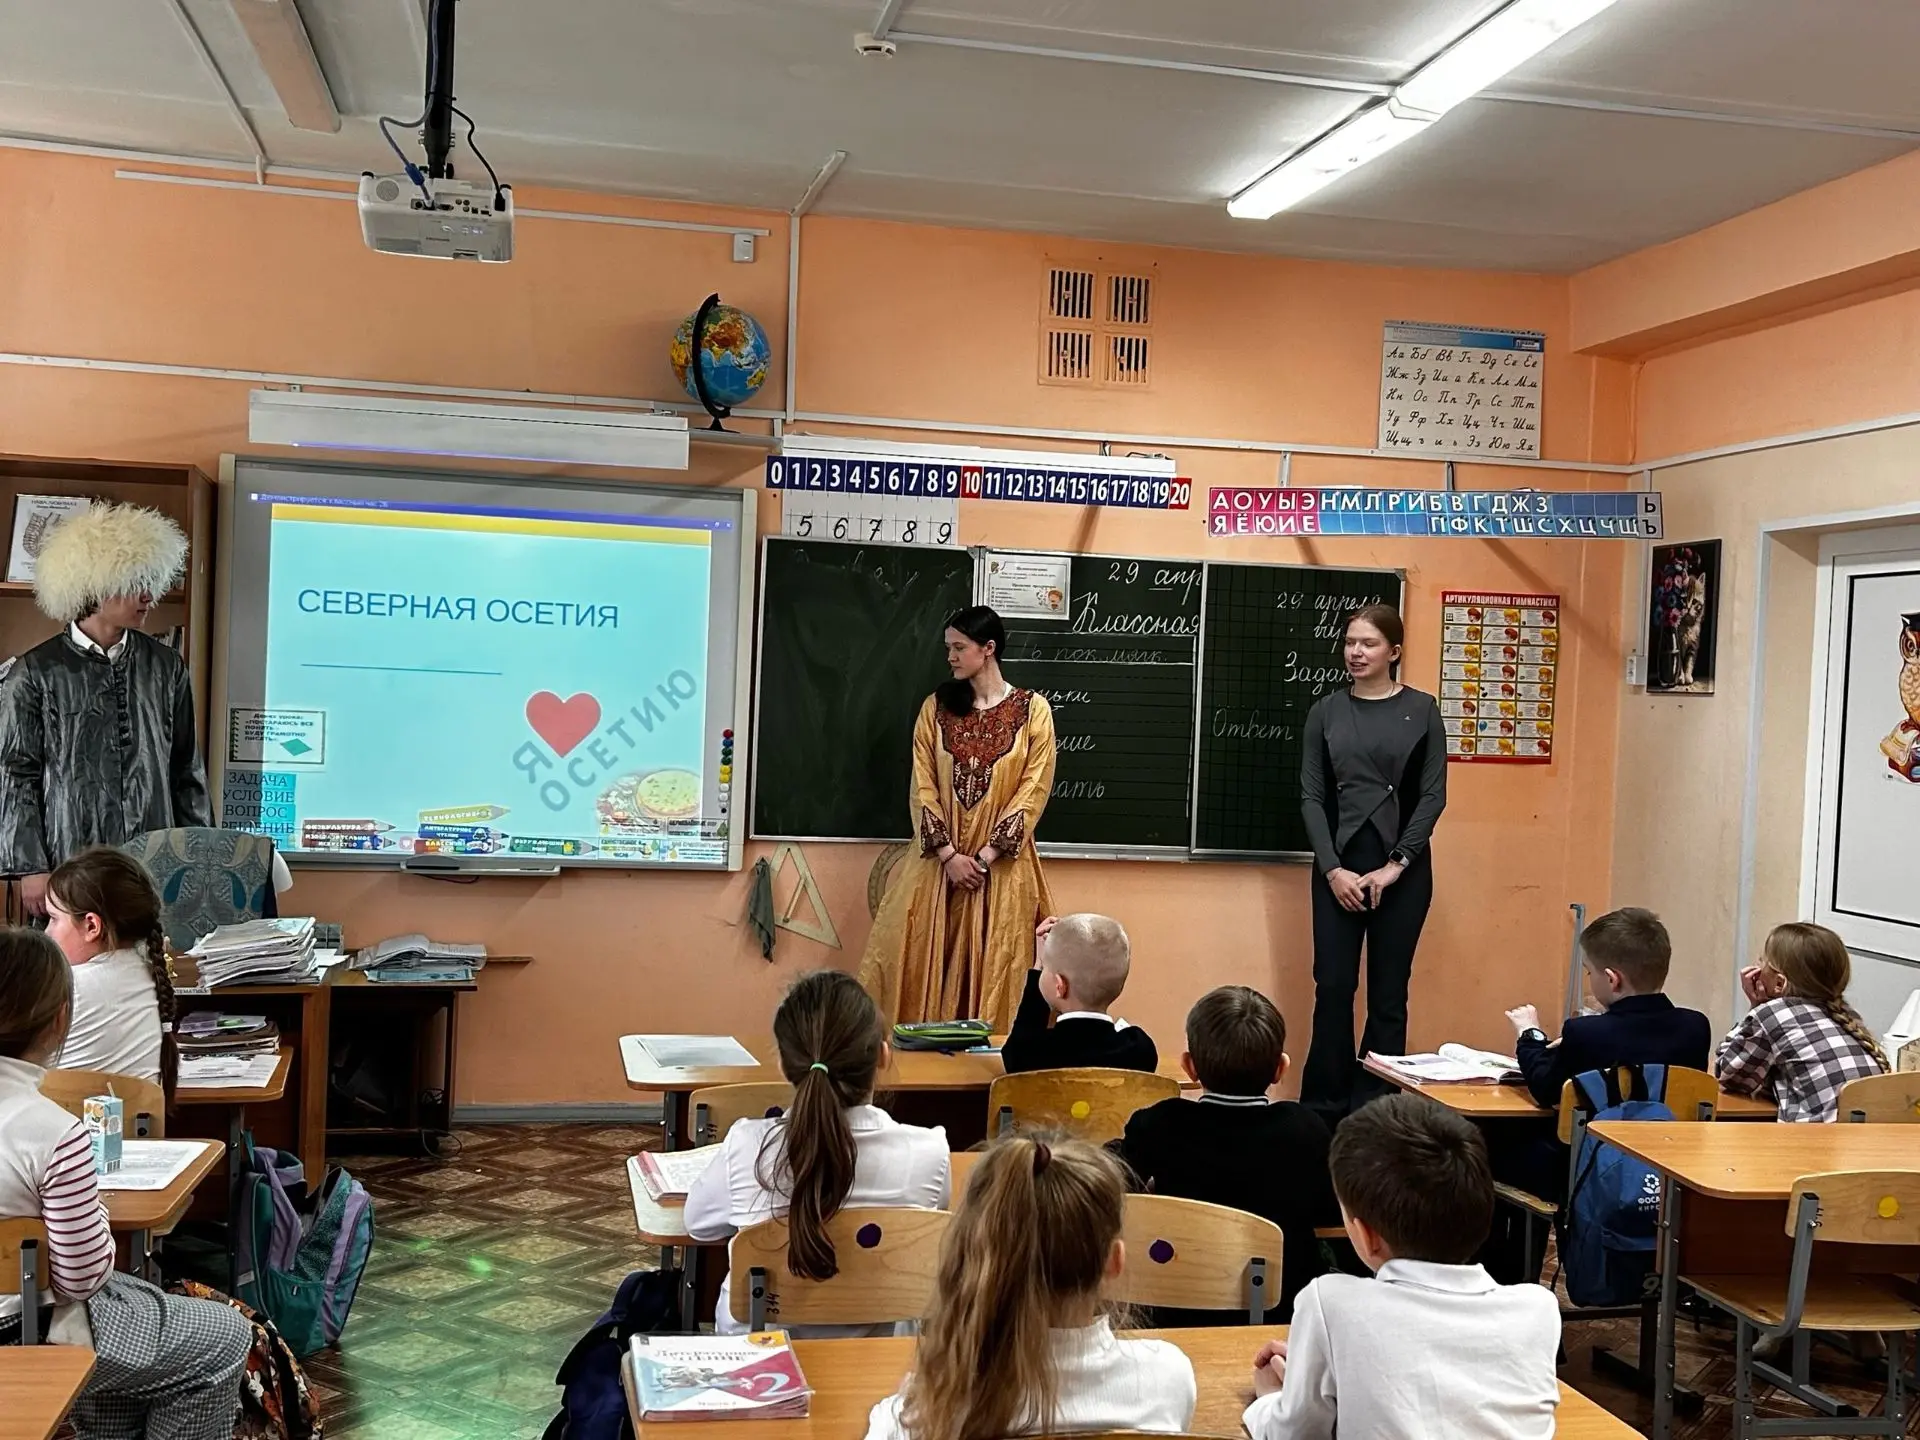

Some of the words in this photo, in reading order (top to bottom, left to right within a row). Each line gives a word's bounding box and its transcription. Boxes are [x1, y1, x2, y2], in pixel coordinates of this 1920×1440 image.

[771, 461, 783, 484] 0
[792, 463, 800, 485] 1
[810, 464, 821, 486] 2
[830, 465, 841, 487] 3
[850, 466, 861, 488] 4
[869, 467, 880, 489] 5
[889, 468, 900, 490] 6
[908, 469, 920, 491] 7
[927, 470, 938, 492] 8
[947, 471, 958, 493] 9
[964, 471, 980, 493] 10
[985, 472, 1001, 494] 11
[1006, 473, 1023, 496] 12
[1027, 474, 1044, 497] 13
[1048, 476, 1066, 498] 14
[1069, 477, 1086, 499] 15
[1090, 478, 1107, 500] 16
[1111, 479, 1128, 502] 17
[1131, 480, 1148, 503] 18
[1152, 481, 1169, 504] 19
[1170, 483, 1190, 505] 20
[796, 515, 813, 537] 5
[833, 517, 849, 540] 6
[869, 519, 883, 541] 7
[902, 520, 917, 543] 8
[937, 522, 951, 544] 9
[1108, 561, 1139, 584] 29
[298, 588, 477, 622] СЕВЕРНАЯ
[486, 599, 619, 629] ОСЕТИЯ
[1072, 591, 1200, 634] Классная
[1277, 592, 1304, 609] 29
[1445, 594, 1511, 605] АРТИКУЛЯЦИОННАЯ
[1512, 596, 1557, 607] ГИМНАСТИКА
[540, 668, 698, 812] ОСЕТИЮ
[512, 741, 553, 784] Я
[229, 772, 288, 787] ЗАДАЧА
[223, 790, 295, 802] УСЛОВИЕ
[225, 805, 288, 818] ВОПРОС
[751, 1373, 806, 1398] 2
